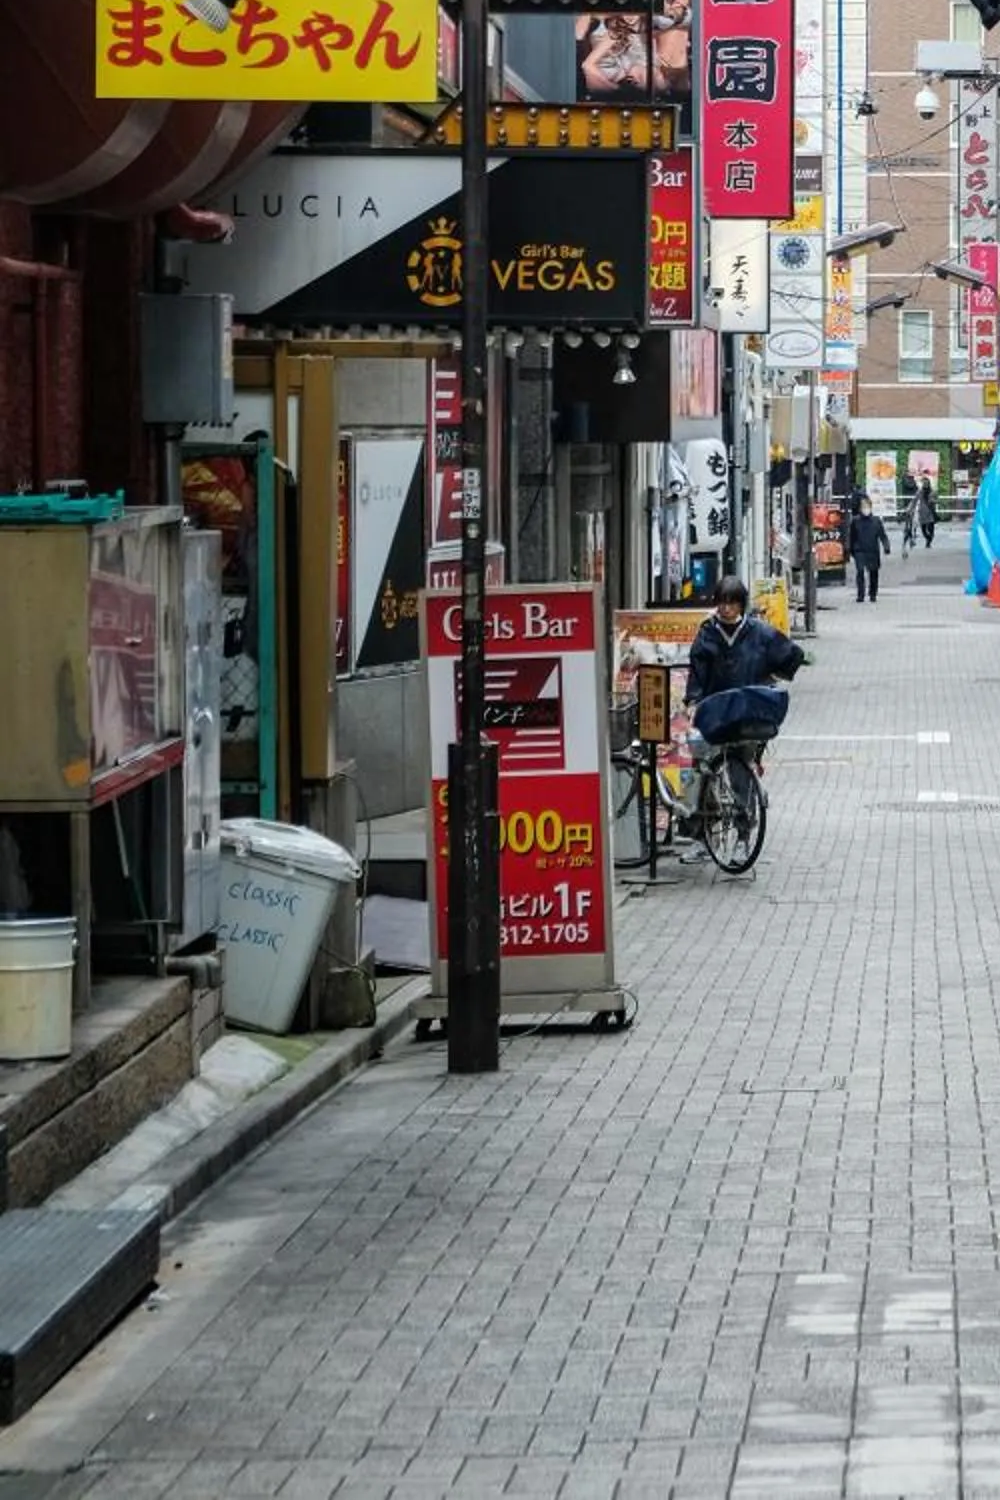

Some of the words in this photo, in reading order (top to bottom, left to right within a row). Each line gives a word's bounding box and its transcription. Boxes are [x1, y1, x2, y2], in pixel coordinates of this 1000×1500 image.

[232, 195, 380, 218] LUCIA
[559, 244, 585, 258] Bar
[492, 259, 615, 291] VEGAS
[443, 605, 515, 641] Grls
[520, 602, 579, 639] Bar
